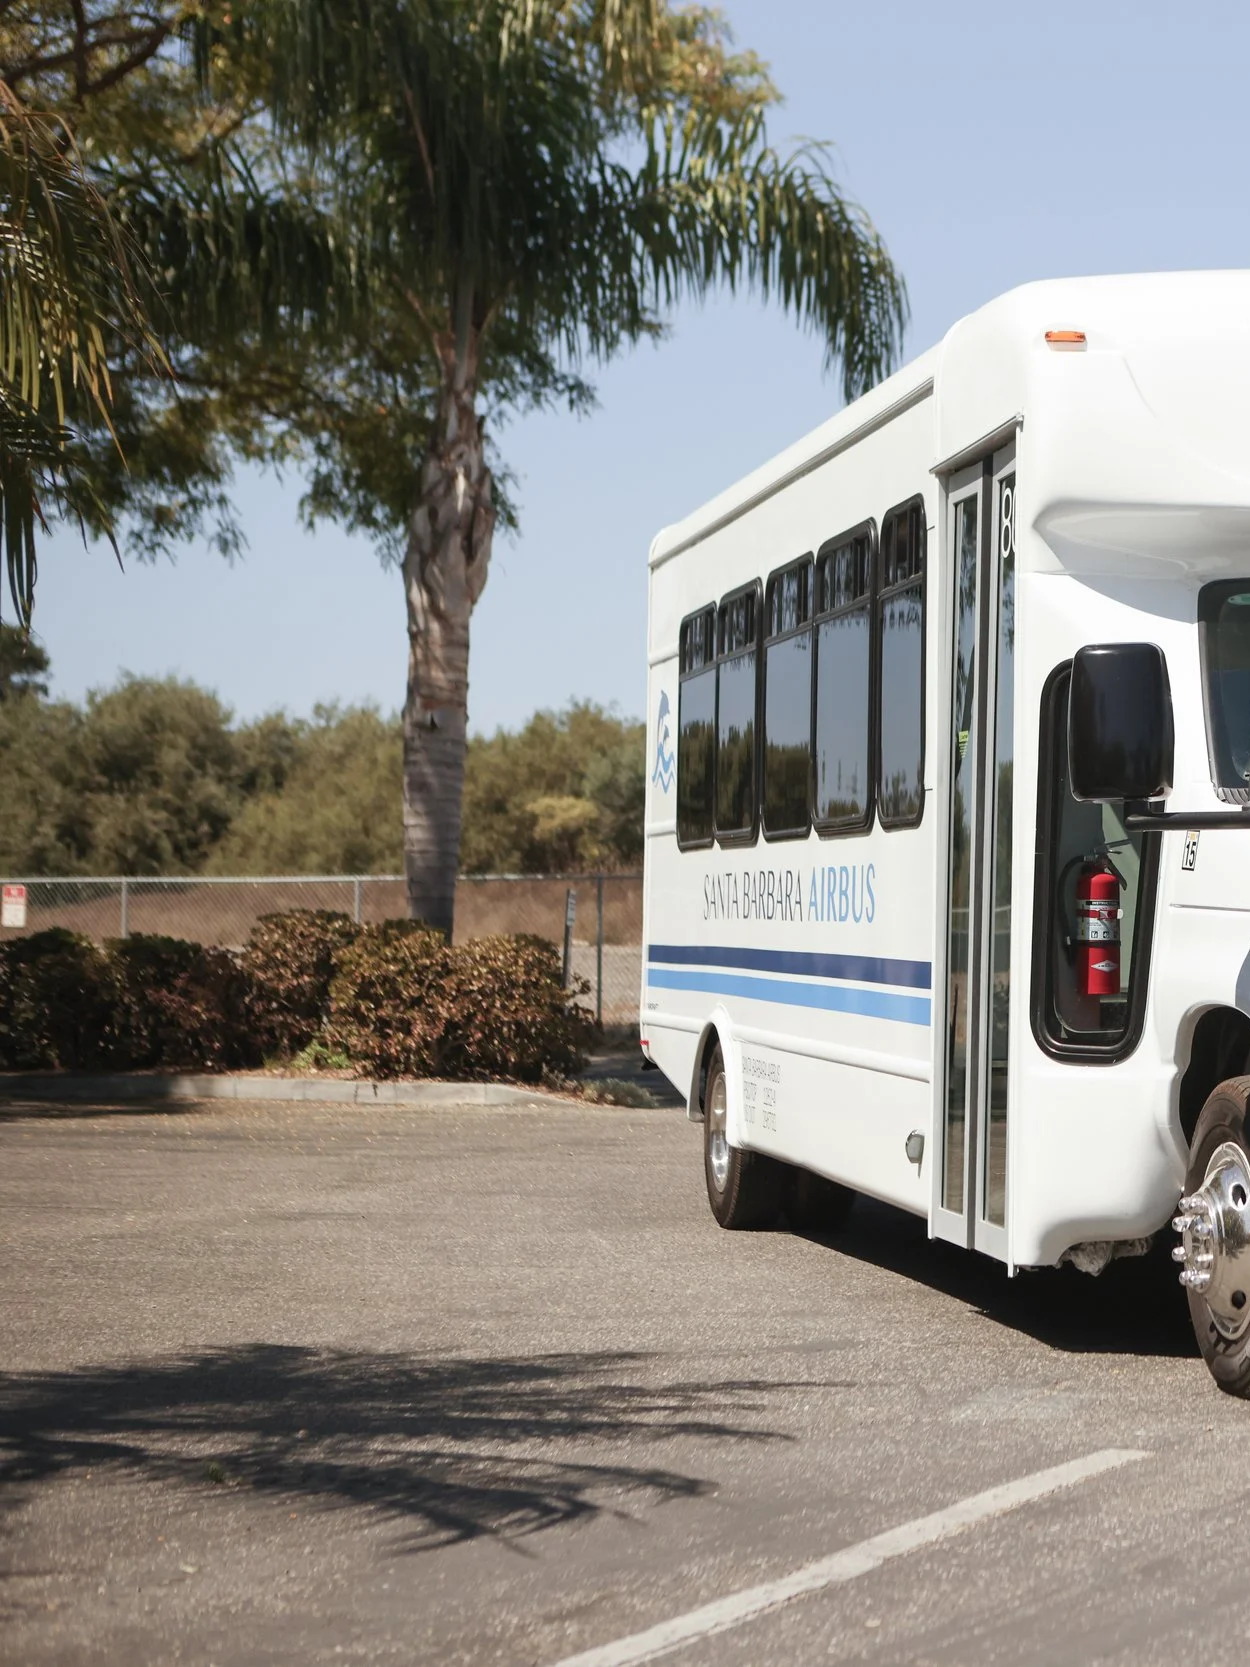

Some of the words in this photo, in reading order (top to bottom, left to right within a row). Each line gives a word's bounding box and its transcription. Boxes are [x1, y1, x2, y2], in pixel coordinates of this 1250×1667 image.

[1185, 840, 1197, 867] 15
[703, 872, 740, 920] SANTA
[743, 868, 803, 922] BARBARA
[808, 863, 876, 923] AIRBUS
